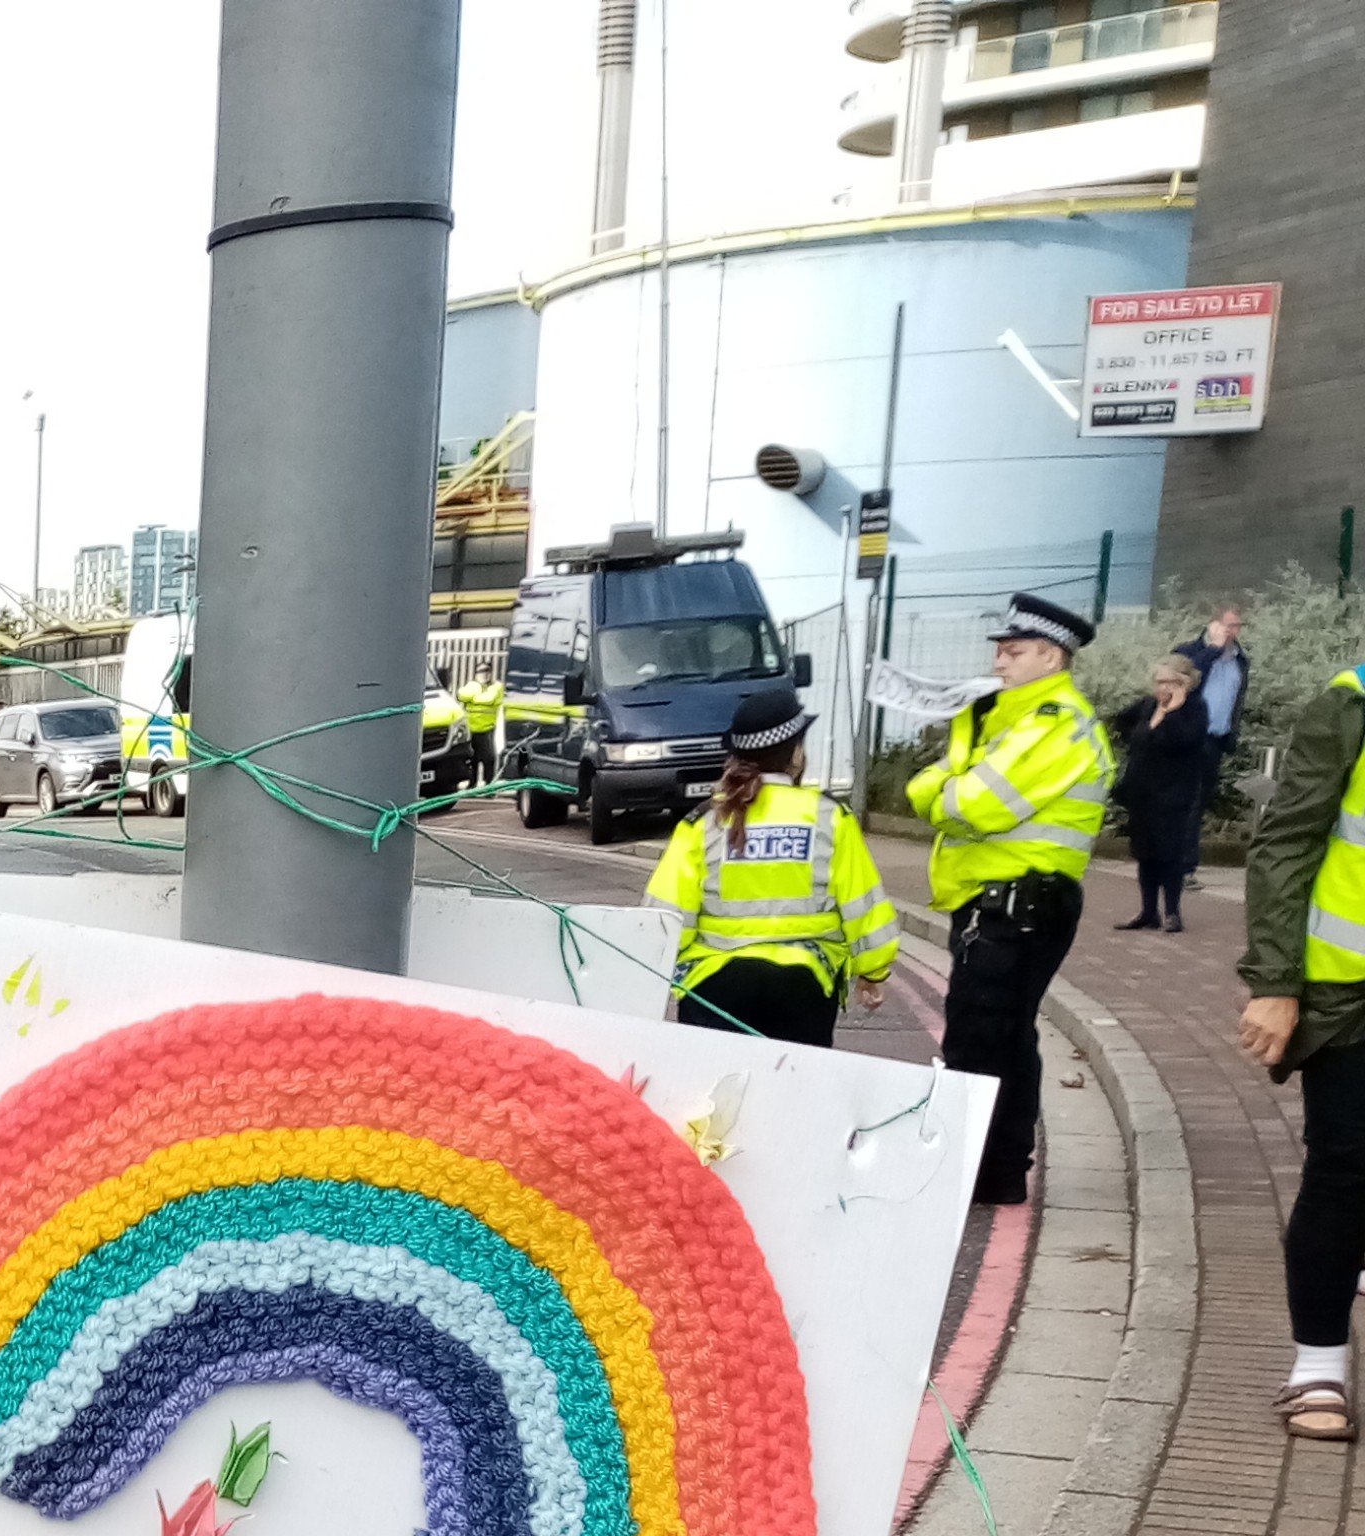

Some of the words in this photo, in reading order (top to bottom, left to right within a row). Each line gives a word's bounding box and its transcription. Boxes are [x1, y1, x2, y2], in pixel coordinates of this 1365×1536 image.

[1101, 301, 1139, 319] FOR
[1228, 292, 1264, 310] LET
[1143, 327, 1214, 345] OFFICE
[1236, 348, 1255, 361] FT
[730, 838, 807, 859] OLICE
